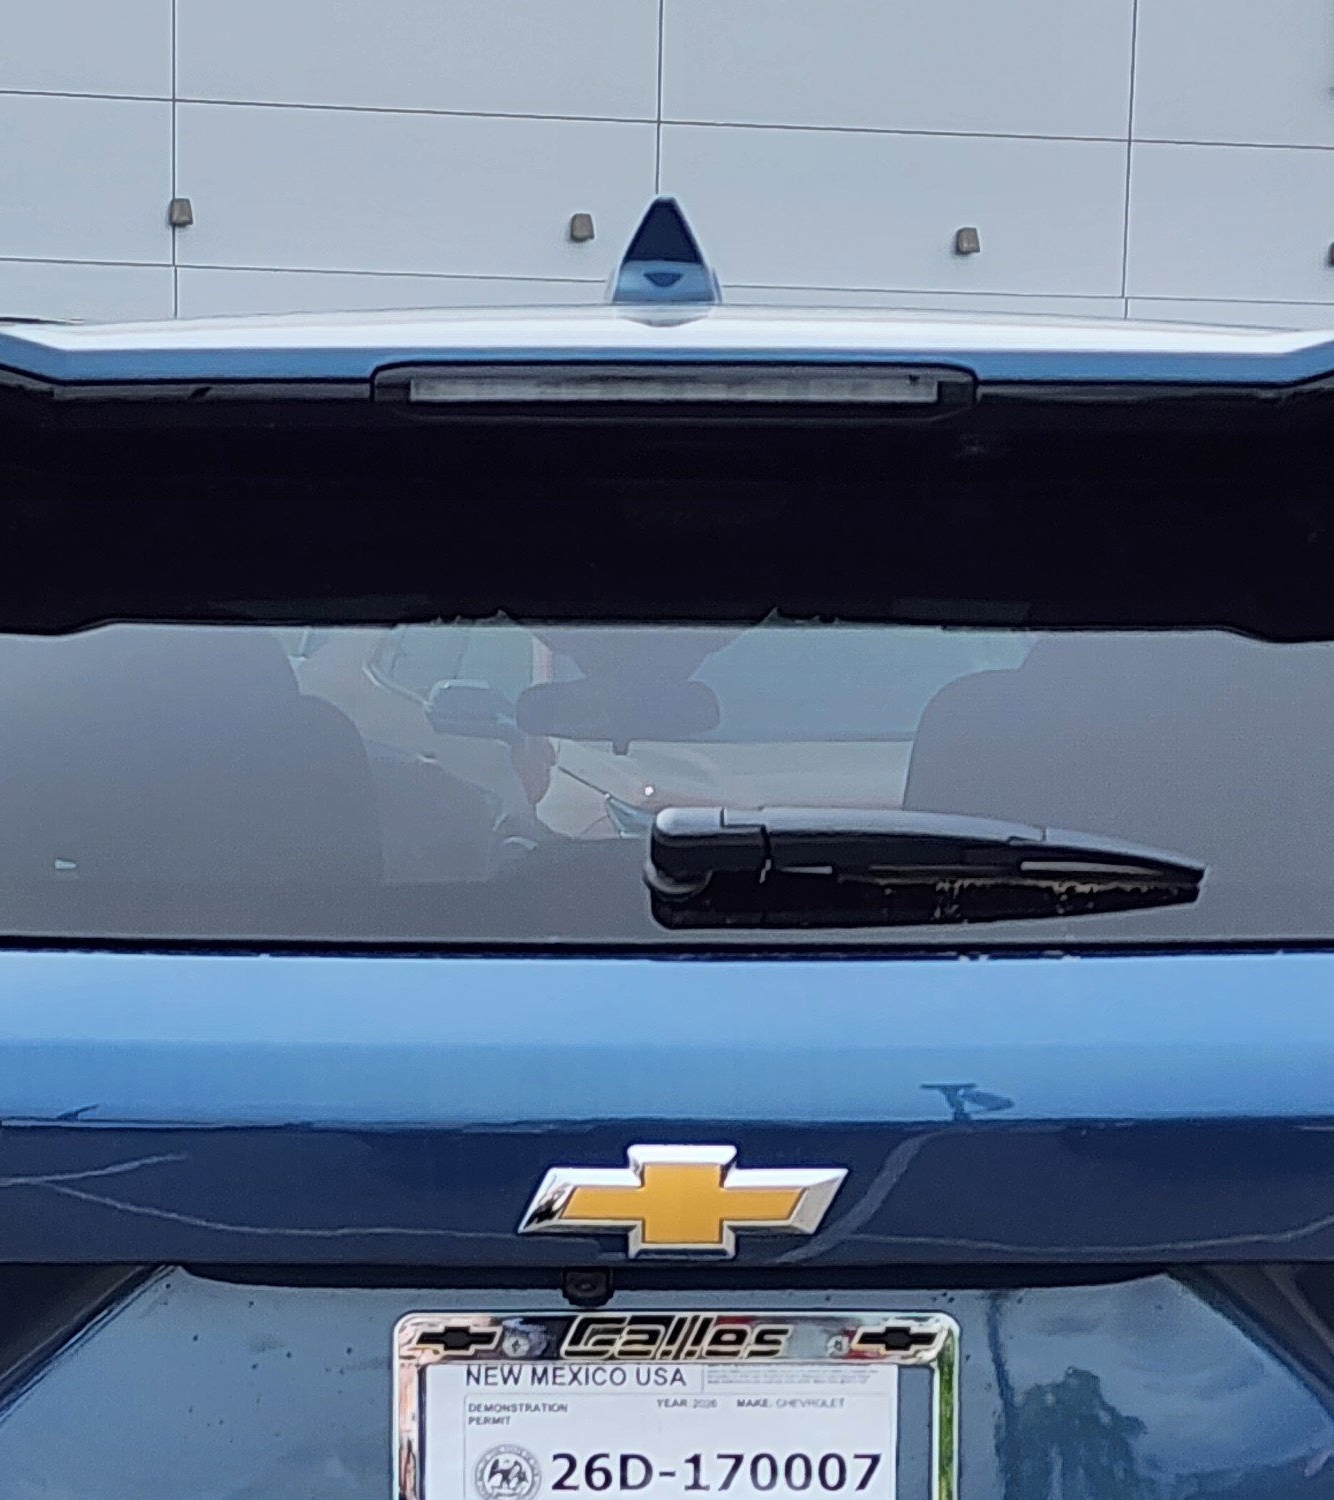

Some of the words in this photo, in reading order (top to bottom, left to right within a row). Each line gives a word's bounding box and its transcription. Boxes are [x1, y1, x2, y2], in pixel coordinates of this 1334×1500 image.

[560, 1313, 794, 1360] Galles
[467, 1365, 523, 1386] NEW
[531, 1366, 627, 1386] MEXICO
[636, 1366, 687, 1386] USA
[468, 1402, 568, 1413] DEMONSTRATION
[468, 1416, 511, 1425] PERMIT
[551, 1452, 883, 1492] 26D-170007
